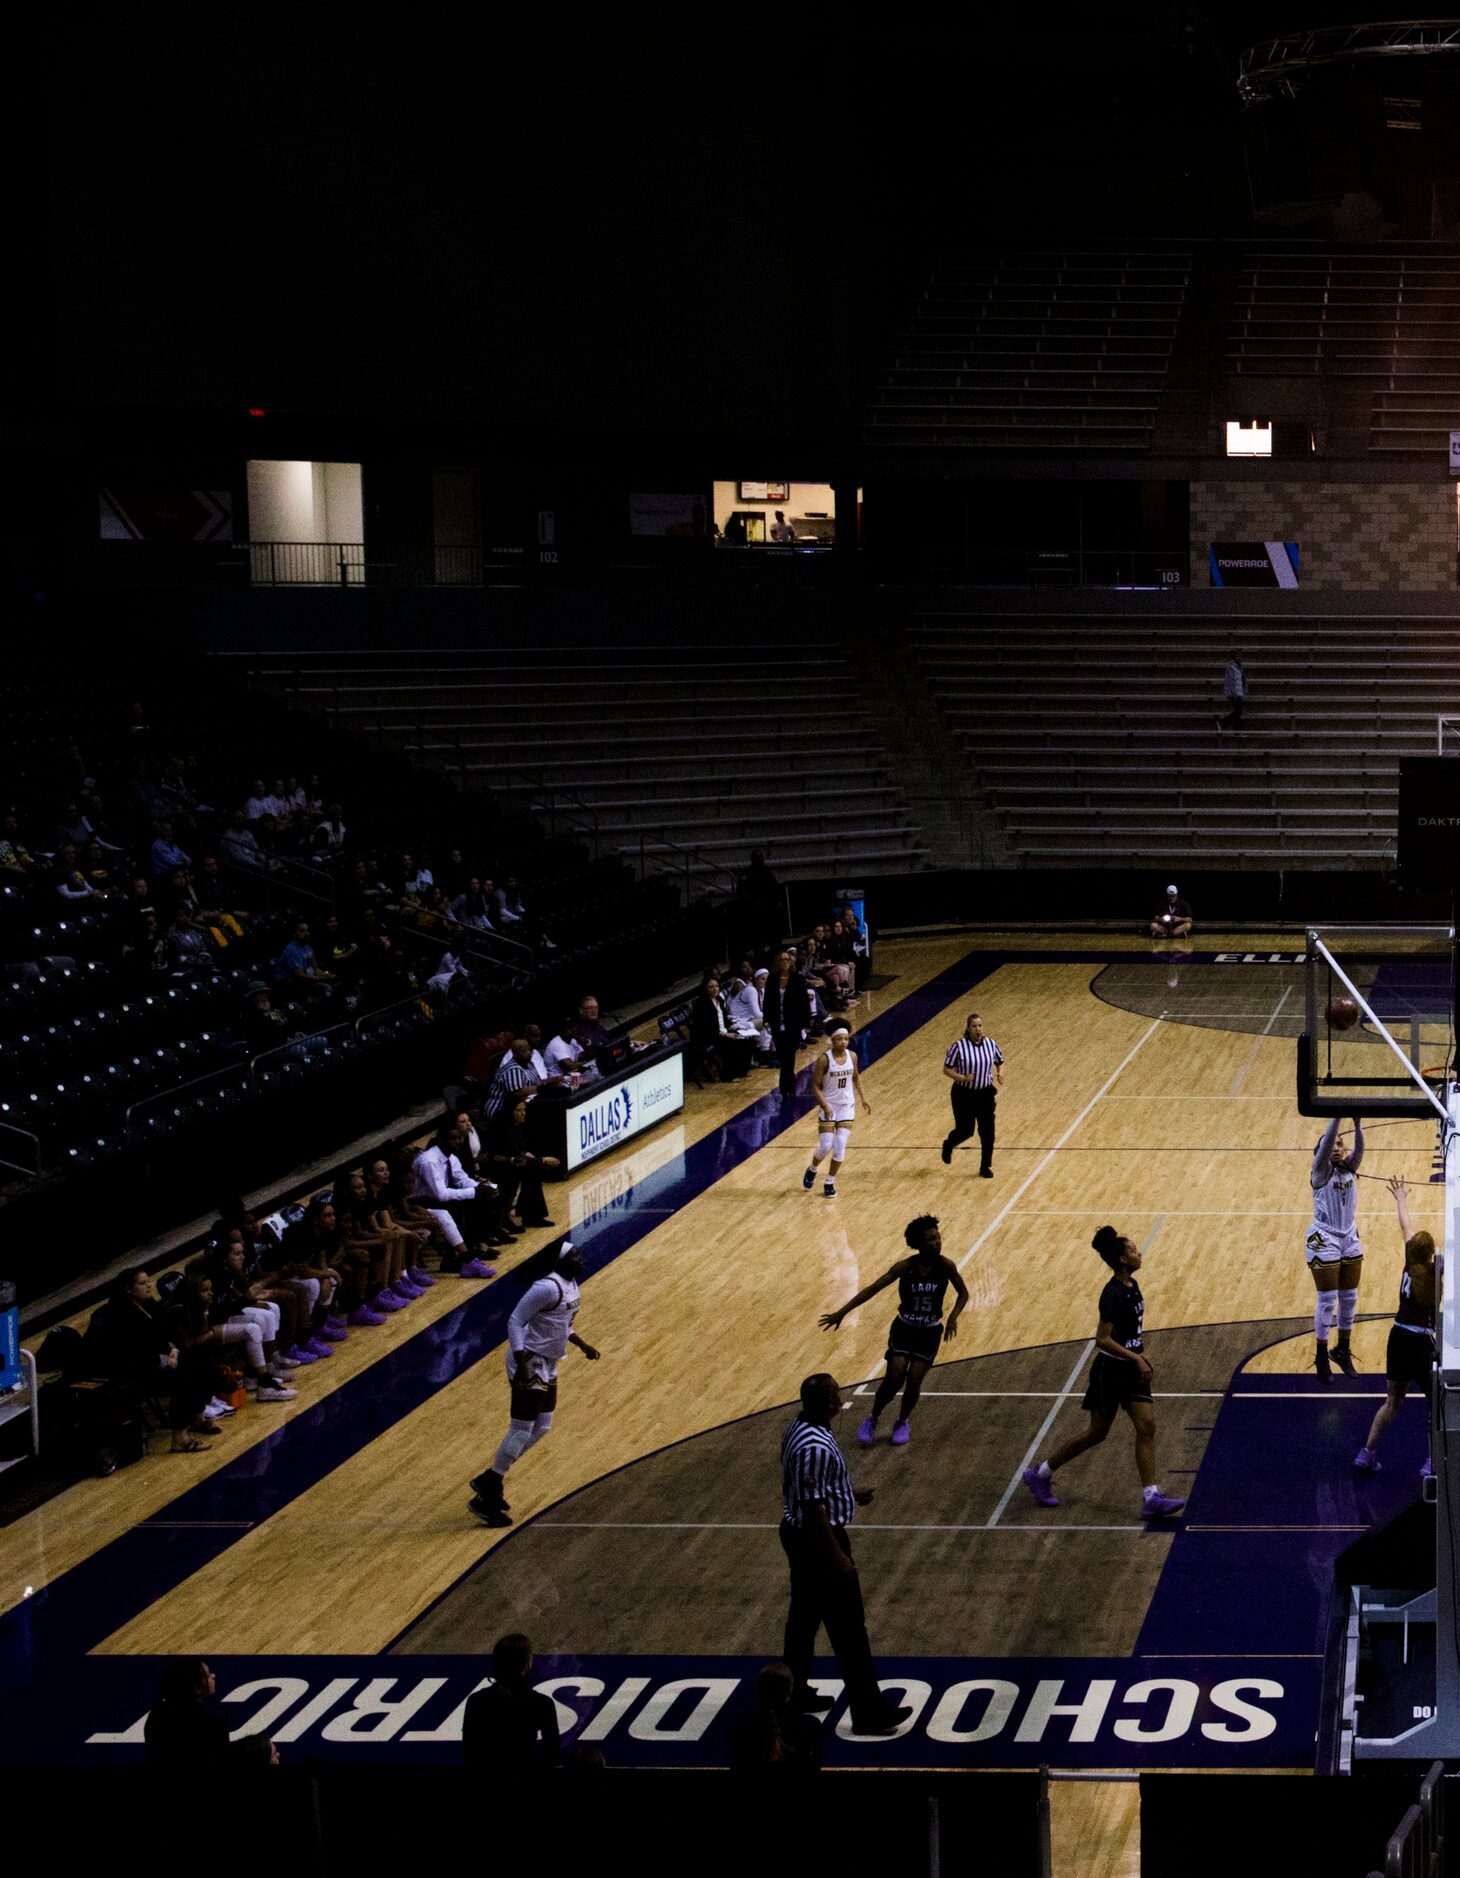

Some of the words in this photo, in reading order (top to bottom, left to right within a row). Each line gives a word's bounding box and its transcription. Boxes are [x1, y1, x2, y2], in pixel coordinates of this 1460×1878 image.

[539, 551, 558, 563] 102
[1218, 560, 1269, 568] POWERADE
[1161, 571, 1180, 583] 103
[1213, 953, 1308, 964] ELLI
[580, 1097, 621, 1150] DALLAS
[911, 1282, 938, 1293] LADY
[912, 1295, 934, 1313] 15
[1412, 1705, 1431, 1719] DO
